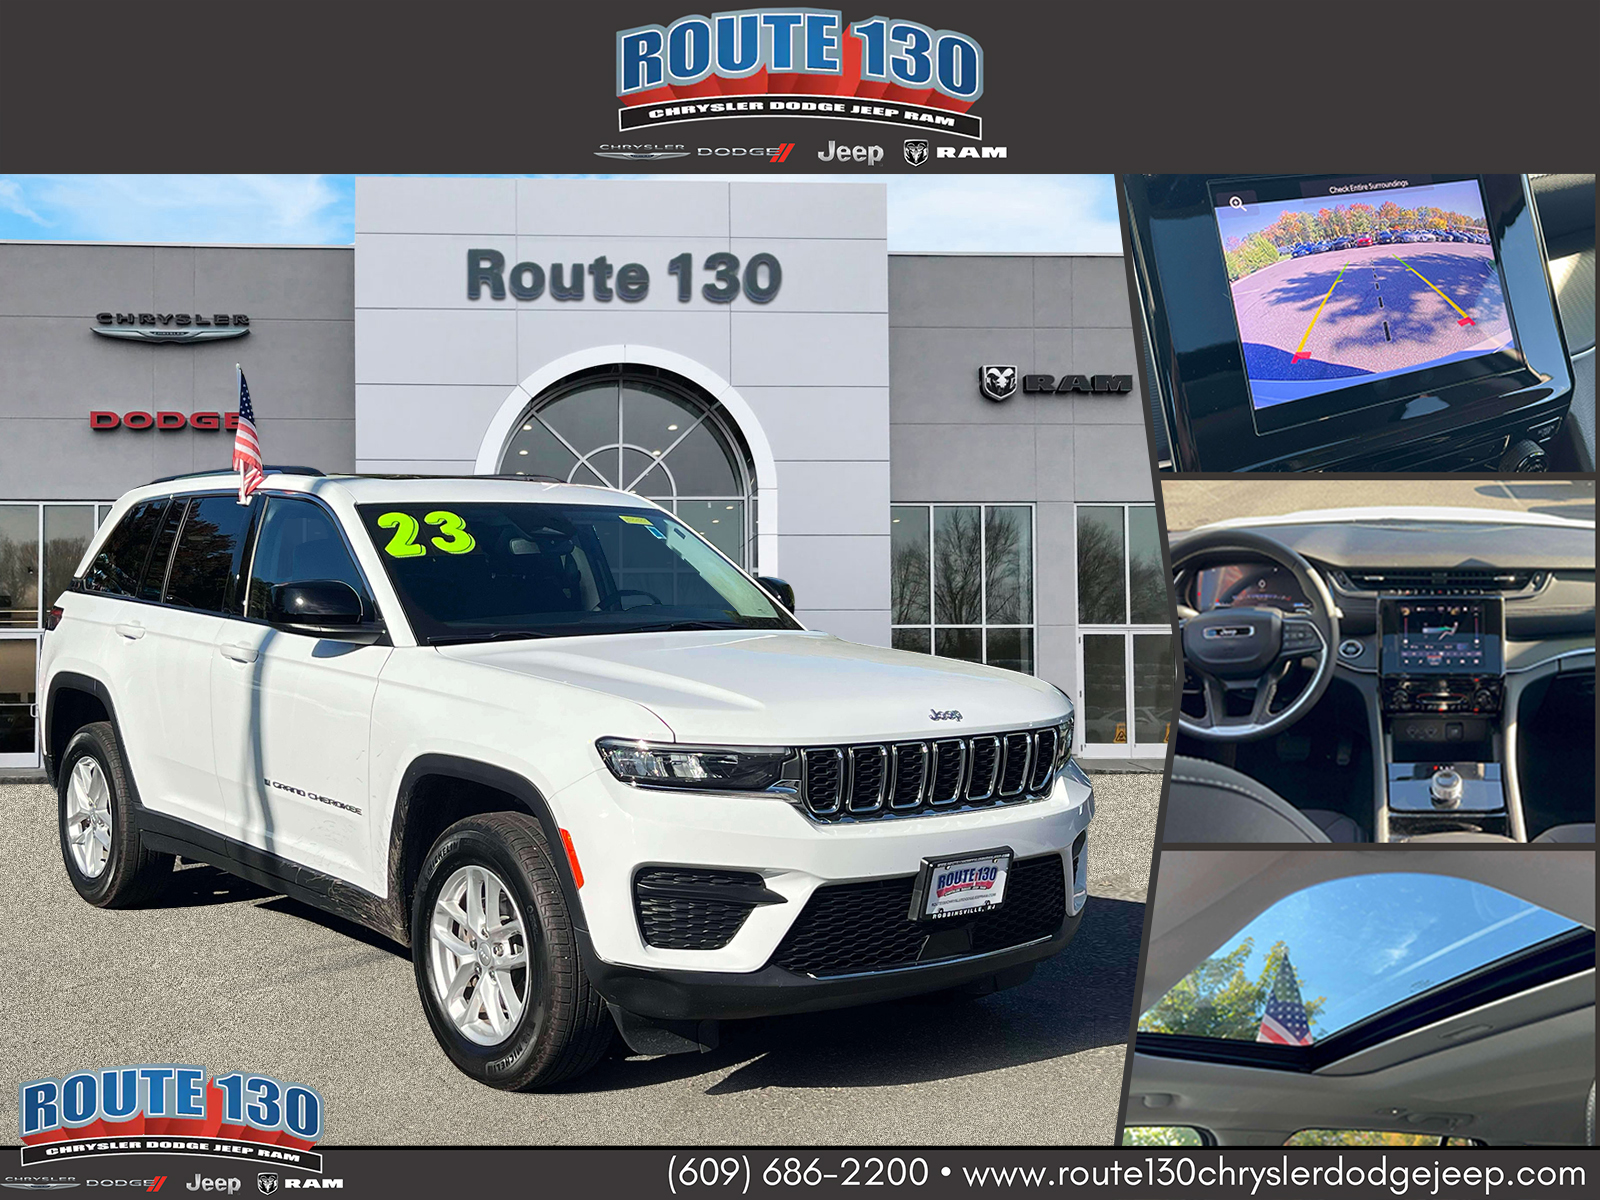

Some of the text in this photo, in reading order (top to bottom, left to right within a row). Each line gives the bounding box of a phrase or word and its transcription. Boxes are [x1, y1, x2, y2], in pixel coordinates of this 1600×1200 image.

[1329, 185, 1349, 194] Check
[1368, 180, 1409, 189] Surroundings
[467, 248, 783, 304] Route 130
[96, 312, 250, 326] CHRYSLER
[1022, 374, 1133, 395] RAM
[377, 510, 476, 558] 23
[929, 708, 963, 722] Jeep
[272, 781, 363, 816] GRAND CHEROKEE
[937, 866, 998, 890] ROUTE 130
